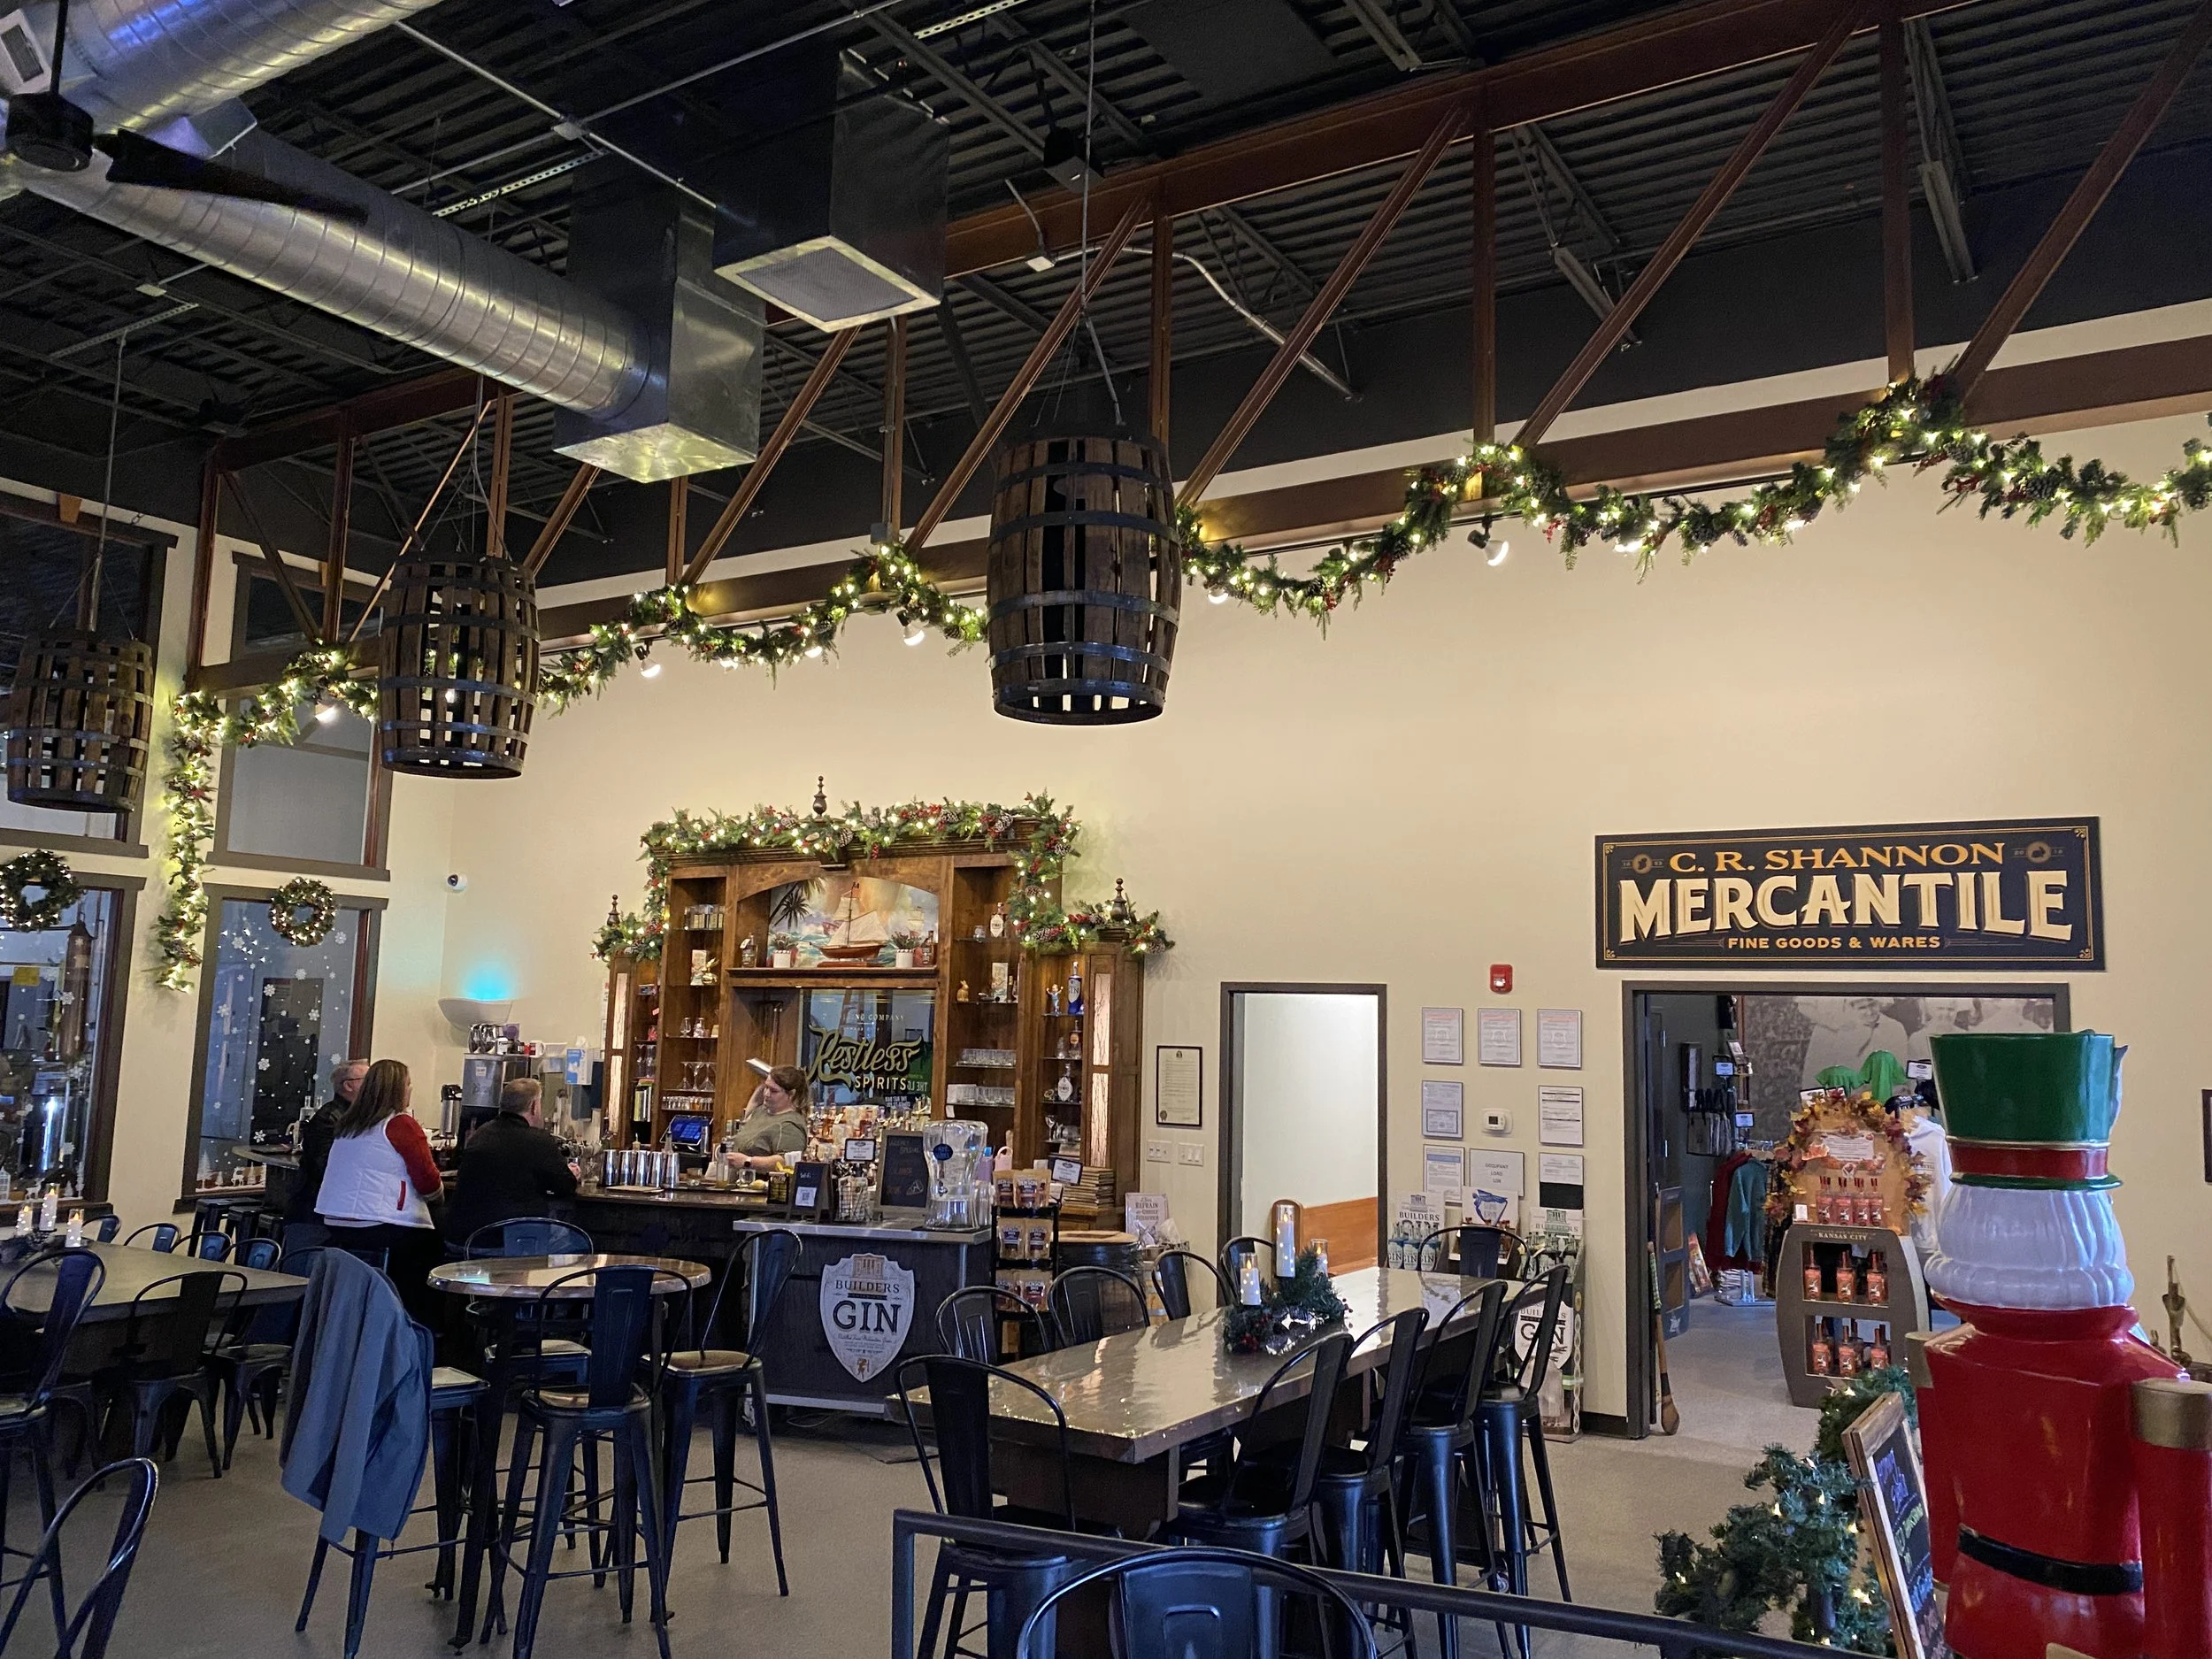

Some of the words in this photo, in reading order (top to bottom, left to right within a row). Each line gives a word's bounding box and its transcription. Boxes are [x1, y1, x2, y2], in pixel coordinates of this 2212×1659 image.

[1669, 852, 1705, 872] C.
[1715, 851, 1755, 872] R.
[1764, 842, 2005, 870] SHANNON
[1619, 870, 2072, 944] MERCANTILE
[1728, 937, 1770, 949] FINE
[1776, 937, 1841, 949] GOODS
[1848, 937, 1862, 949] &
[1870, 936, 1940, 949] WARES
[806, 1023, 923, 1091] Restless
[854, 1075, 907, 1091] SPIRITS
[1399, 1211, 1440, 1221] BUILDERS
[835, 1279, 900, 1294] BUILDERS
[833, 1300, 901, 1333] GIN
[1521, 1308, 1566, 1319] BUILS
[1520, 1323, 1566, 1345] GN
